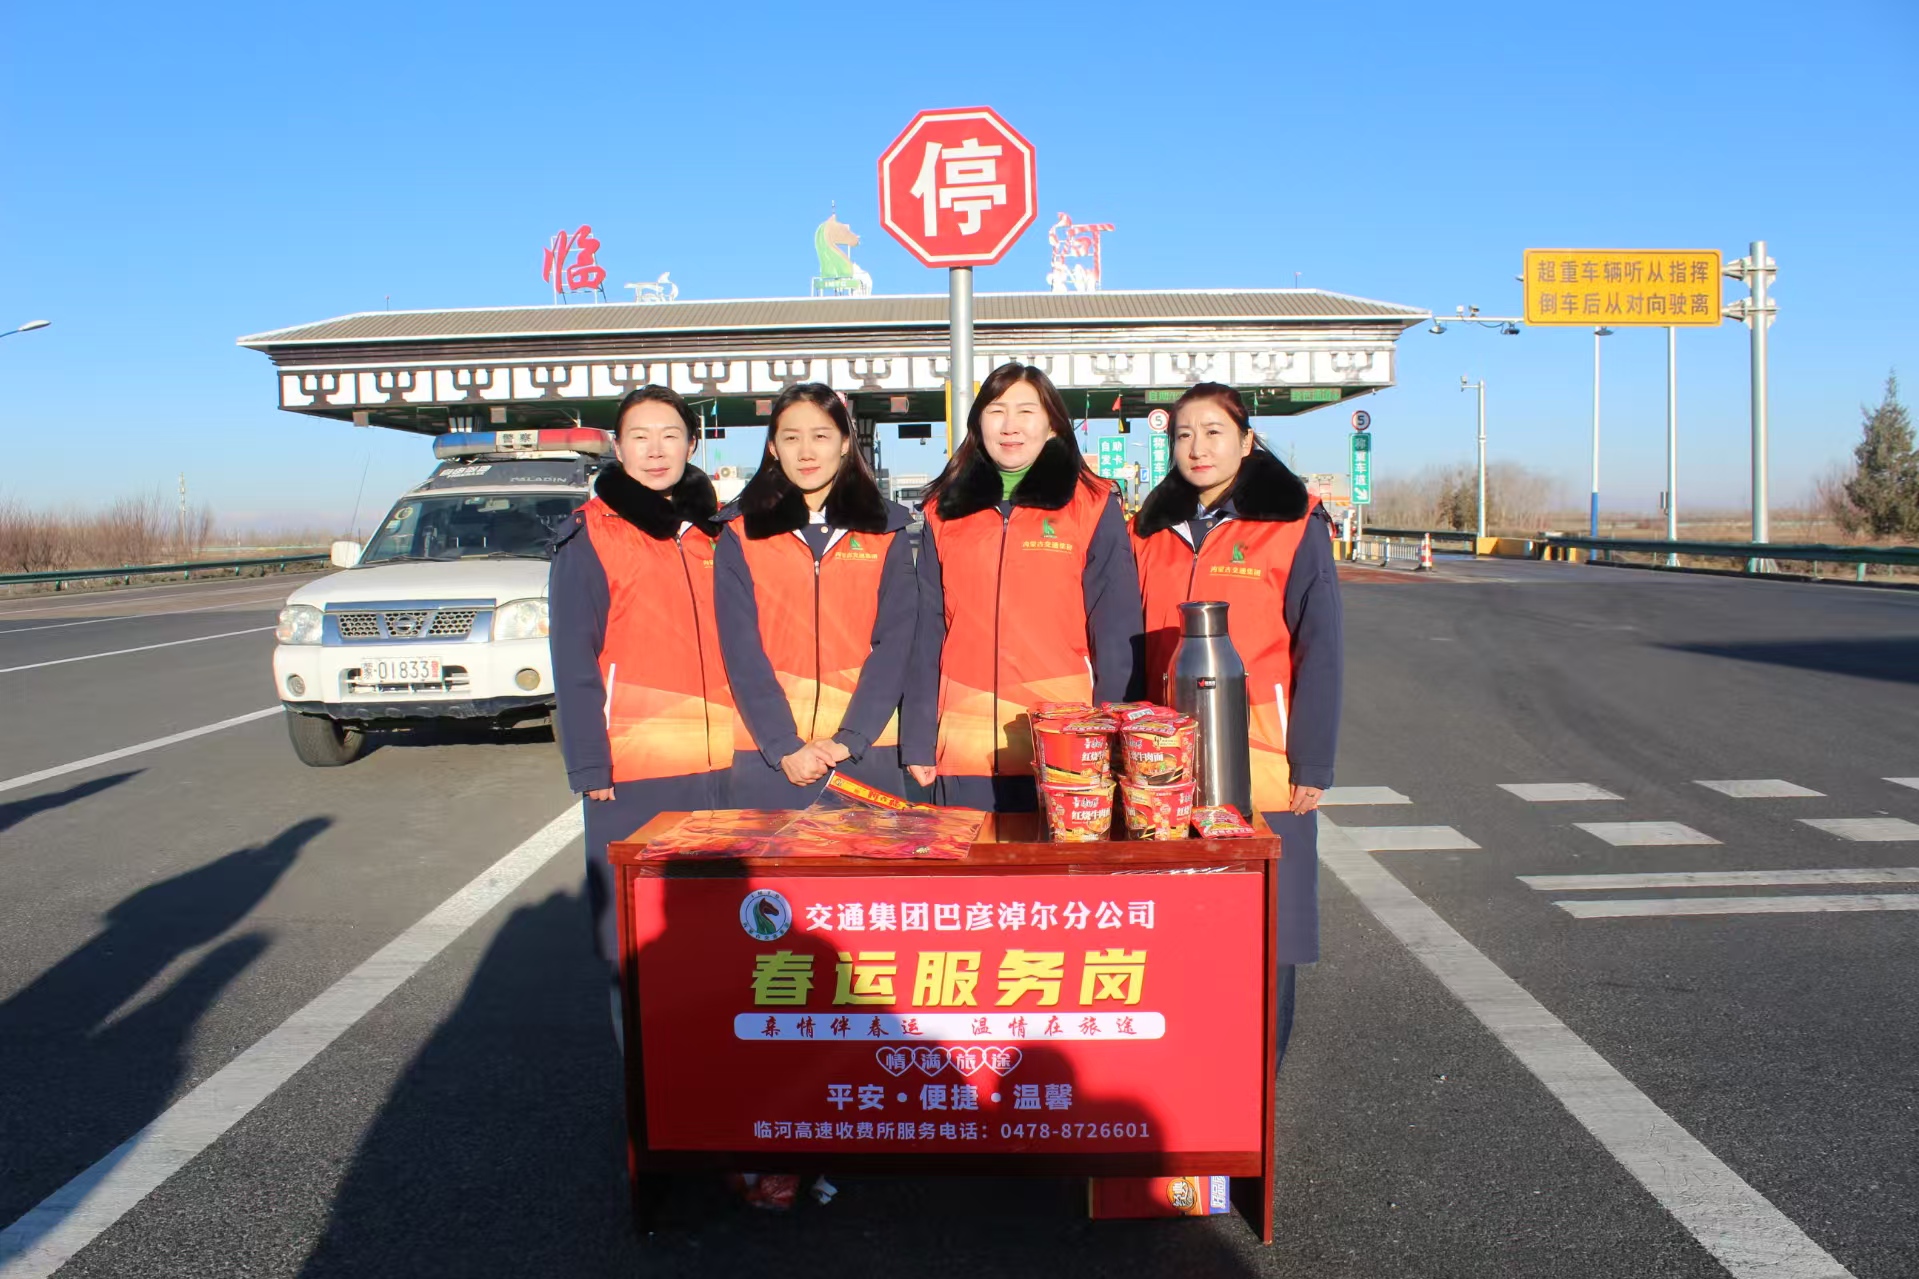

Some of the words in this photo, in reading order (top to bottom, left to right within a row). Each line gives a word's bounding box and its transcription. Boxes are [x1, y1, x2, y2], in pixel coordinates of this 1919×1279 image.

[909, 137, 1007, 237] 停
[1537, 260, 1709, 283] 超重车辆听从指挥
[1539, 292, 1709, 315] 倒车后从对向驶离
[1155, 415, 1163, 426] 5
[1356, 415, 1365, 426] 5
[1101, 441, 1123, 452] 自助
[1101, 454, 1123, 465] 发卡
[804, 899, 1157, 932] 交通集团巴彦淖尔分公司
[749, 948, 1148, 1007] 春运服务岗
[760, 1016, 925, 1039] 亲情伴春运
[971, 1015, 1139, 1039] 温情在旅途
[885, 1052, 1012, 1070] 情满旅途
[1172, 1180, 1188, 1207] 经典
